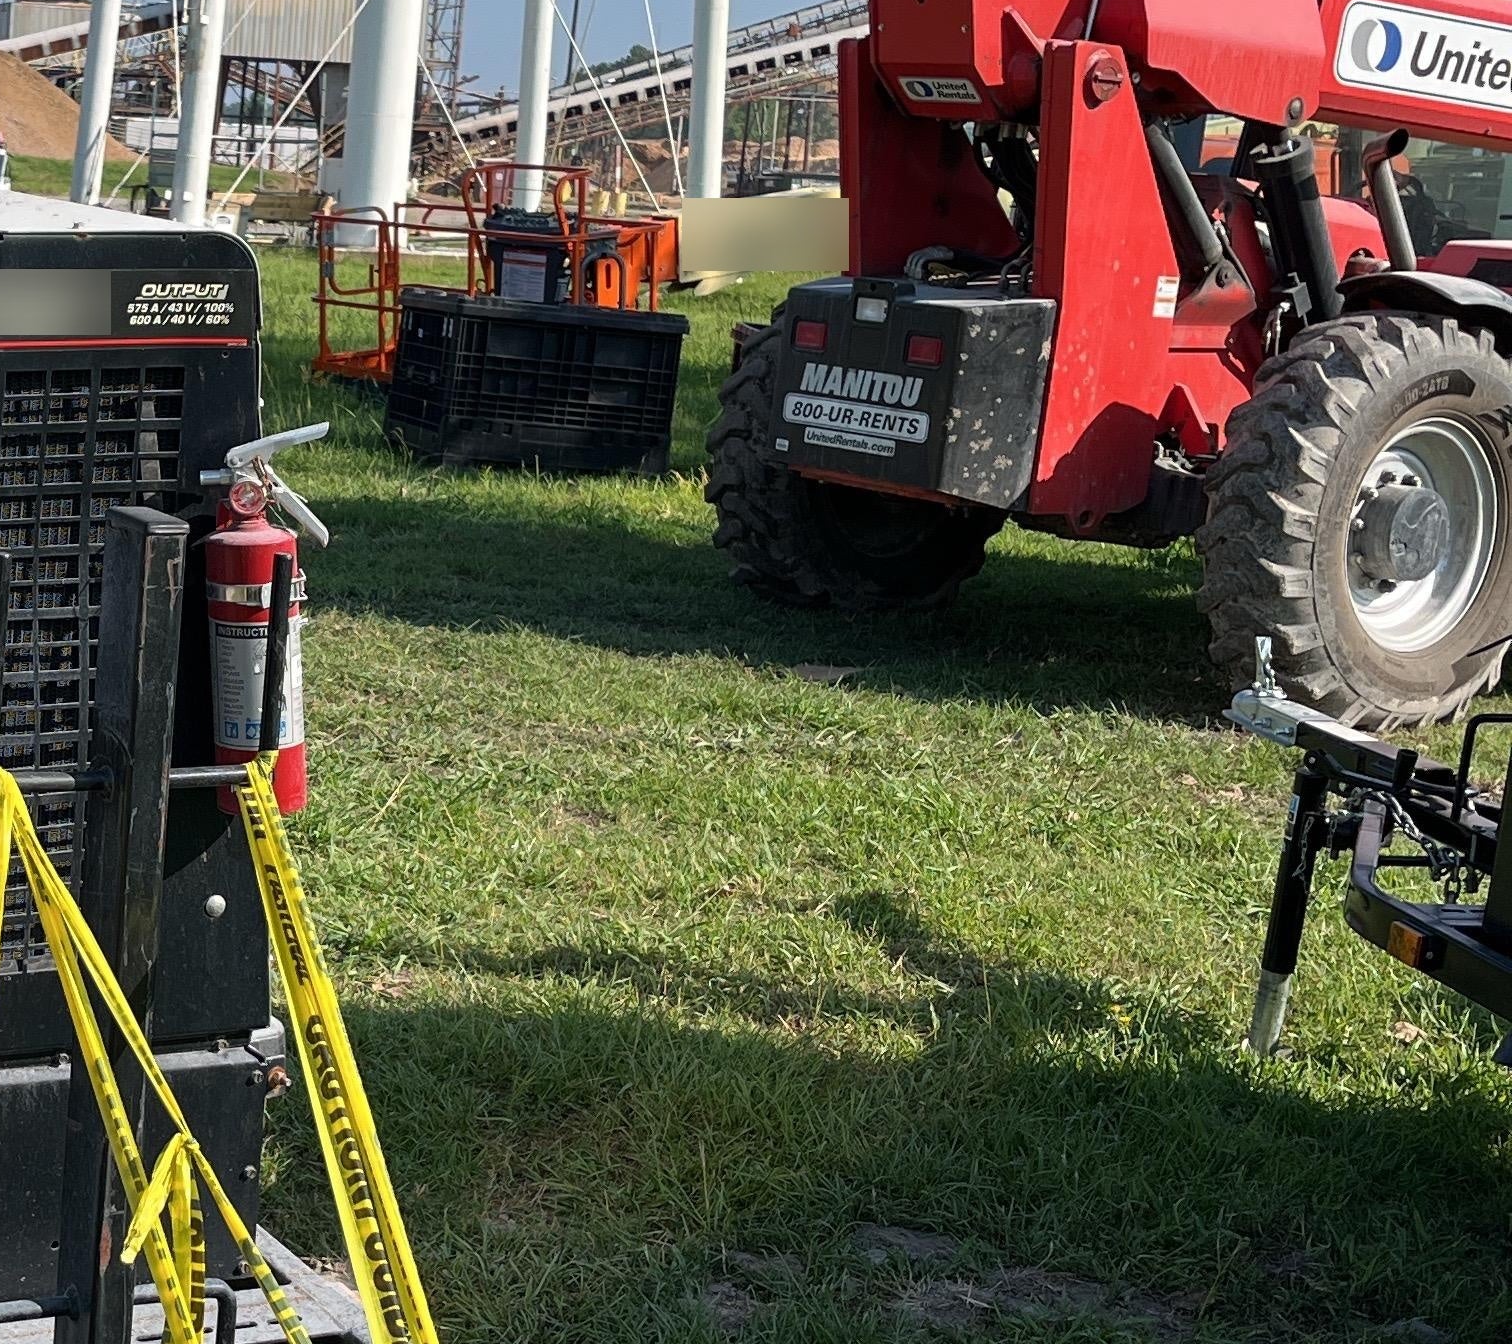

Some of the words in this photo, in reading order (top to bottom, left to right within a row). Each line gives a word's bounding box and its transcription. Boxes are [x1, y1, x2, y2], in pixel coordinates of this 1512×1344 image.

[1410, 31, 1512, 92] Unite
[932, 81, 967, 91] United
[937, 90, 976, 101] Rentals
[141, 283, 223, 297] OUTPUT
[128, 302, 149, 313] 575
[168, 302, 183, 313] 43
[204, 302, 235, 313] 100%
[130, 315, 151, 325] 600
[799, 362, 924, 407] MANITOU
[791, 401, 920, 435] 800-UR-RENTS
[806, 431, 895, 454] UnitedRentals.com
[218, 625, 268, 638] INSTRUCTI
